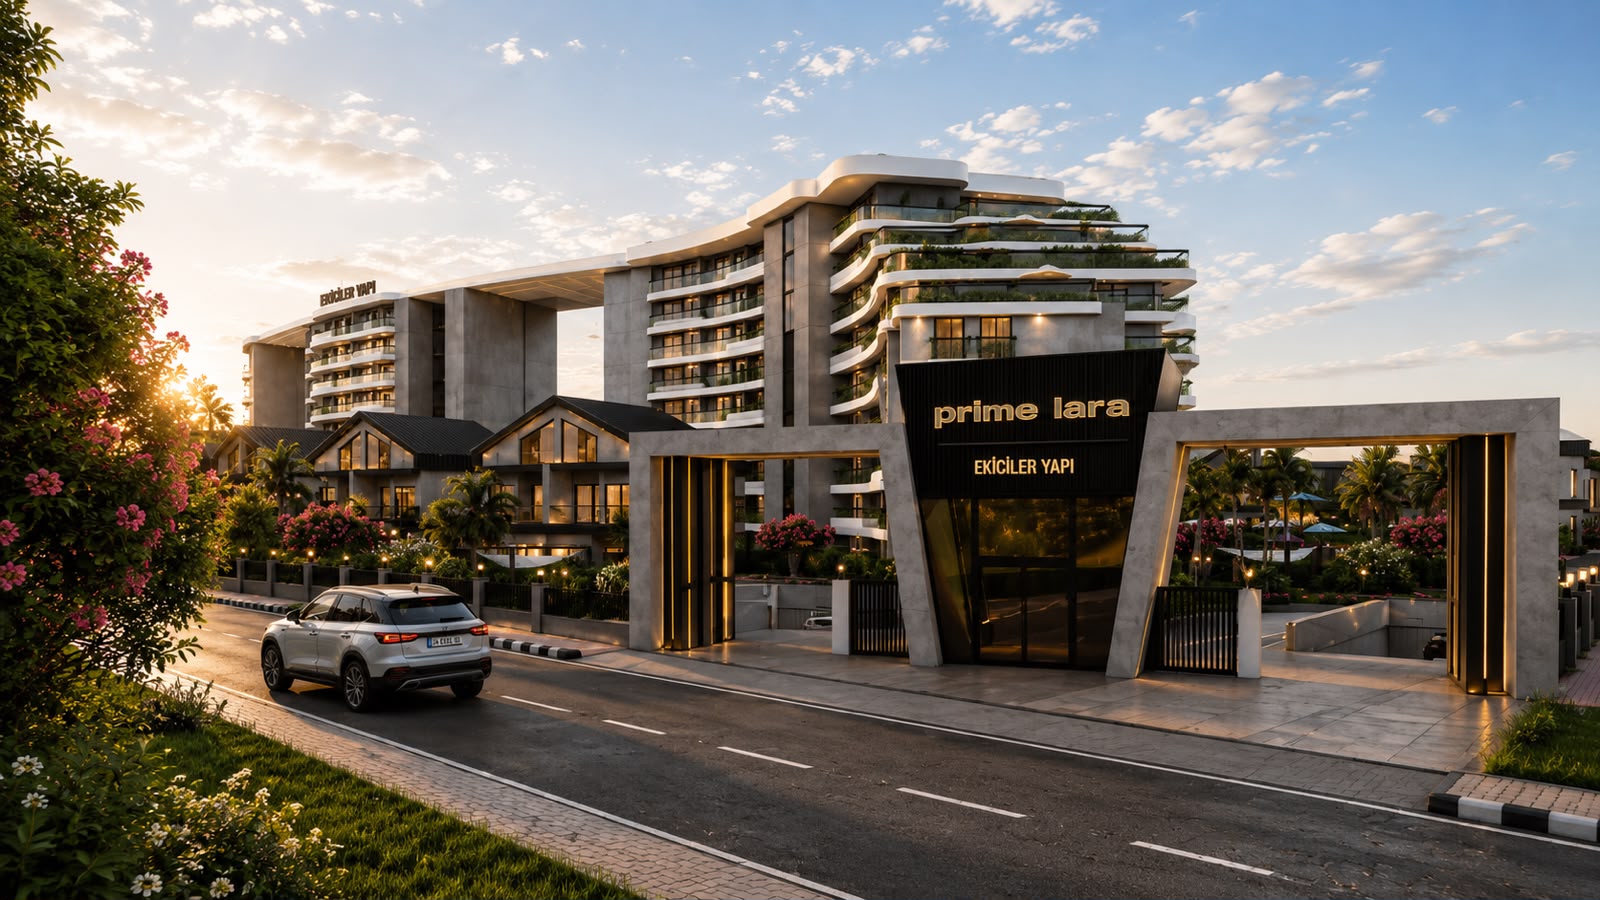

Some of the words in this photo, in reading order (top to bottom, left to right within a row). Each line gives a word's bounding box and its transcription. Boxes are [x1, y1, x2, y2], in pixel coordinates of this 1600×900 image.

[356, 280, 376, 297] YAPI
[934, 400, 1039, 429] prime
[1053, 397, 1130, 419] lara
[974, 456, 1037, 475] EKİCİLER
[1041, 458, 1075, 474] YAPI
